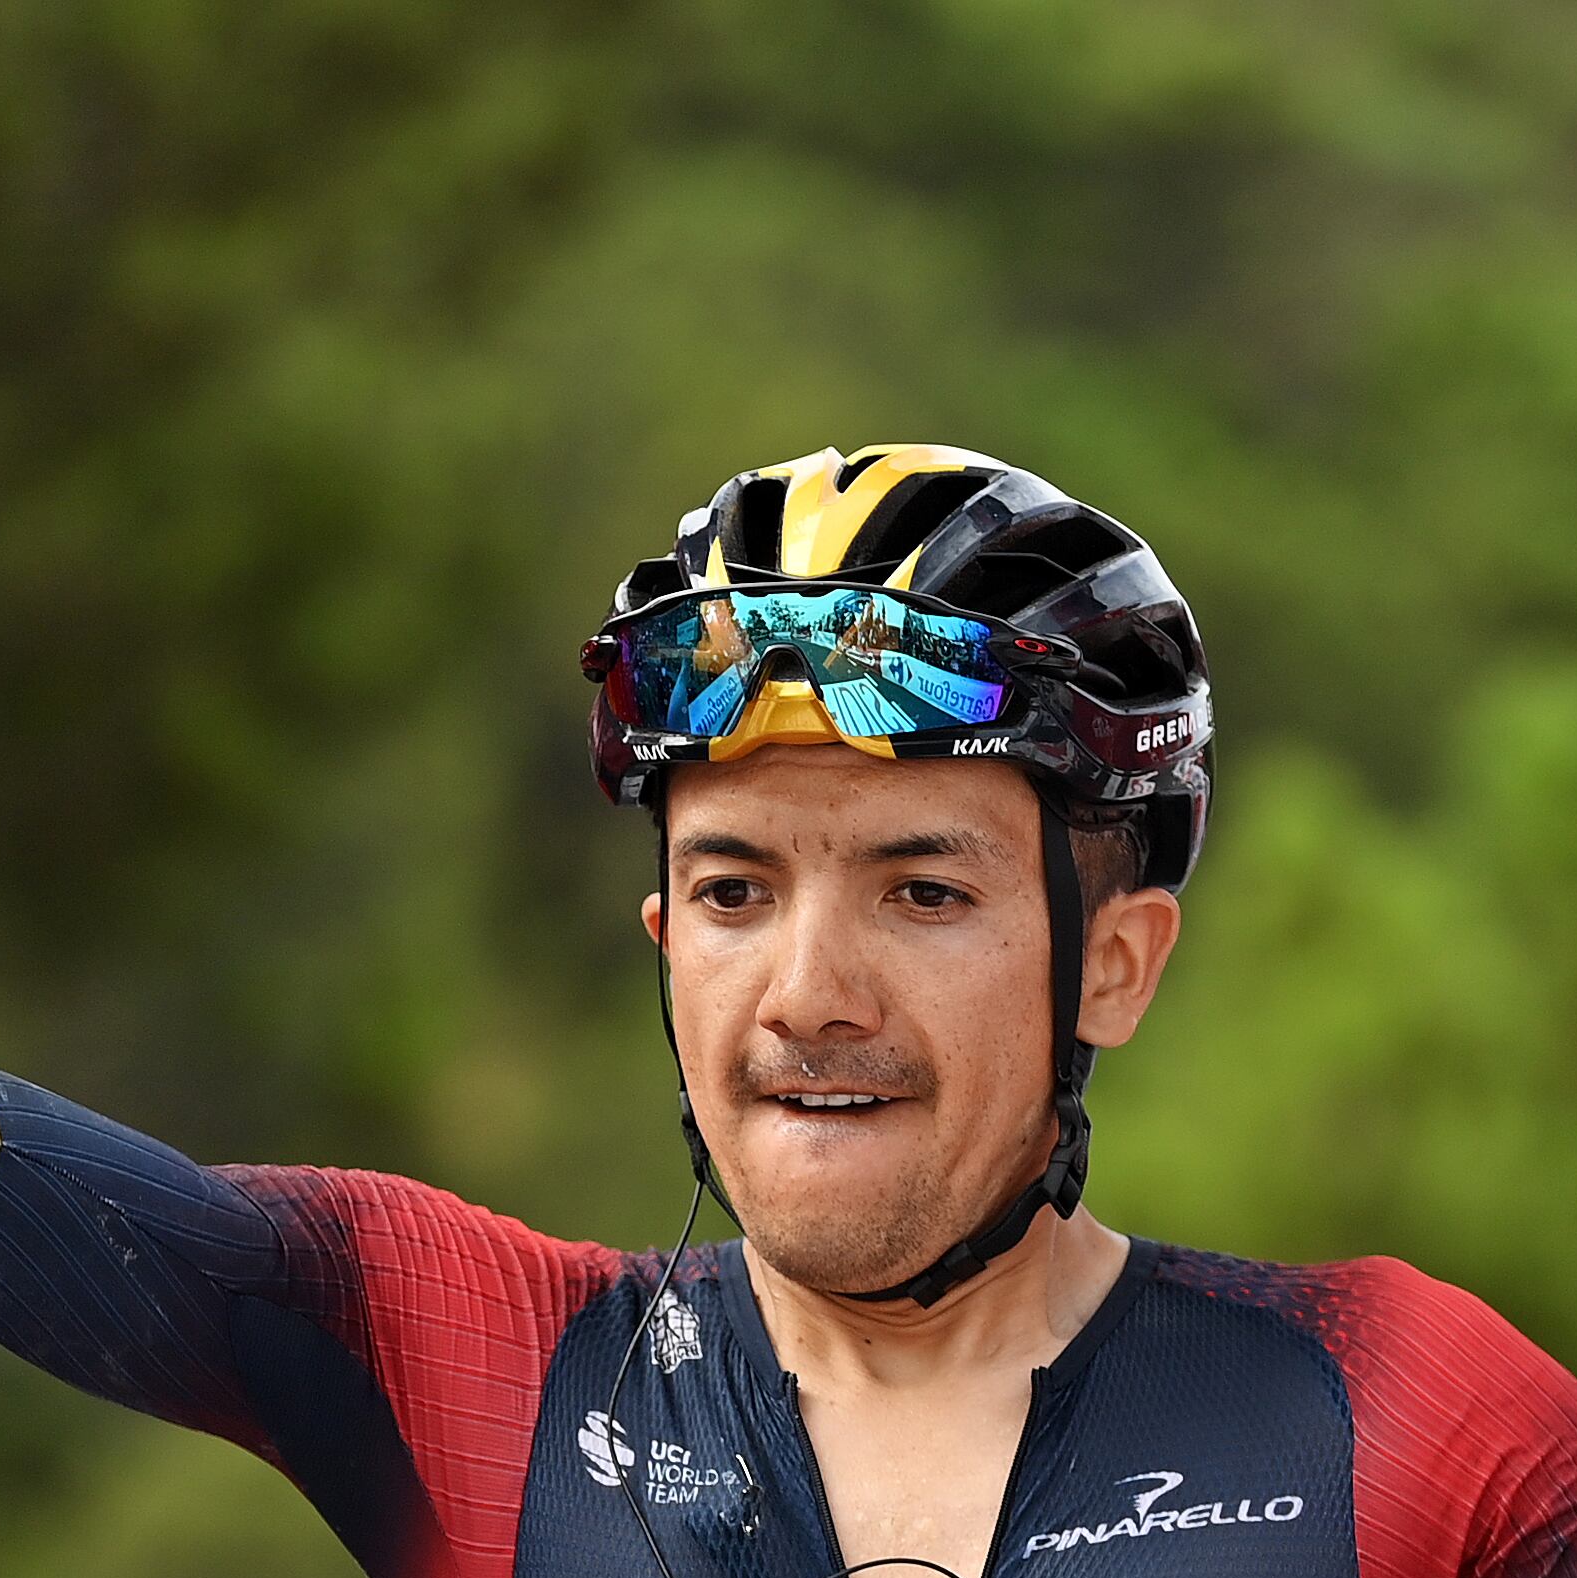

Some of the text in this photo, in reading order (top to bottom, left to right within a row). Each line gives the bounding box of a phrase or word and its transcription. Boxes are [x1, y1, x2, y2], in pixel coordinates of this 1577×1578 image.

[952, 737, 1010, 755] KASK
[650, 1439, 691, 1465] UCI
[647, 1460, 719, 1486] WORLD
[645, 1481, 699, 1504] TEAM
[1023, 1496, 1303, 1559] PINARELLO
